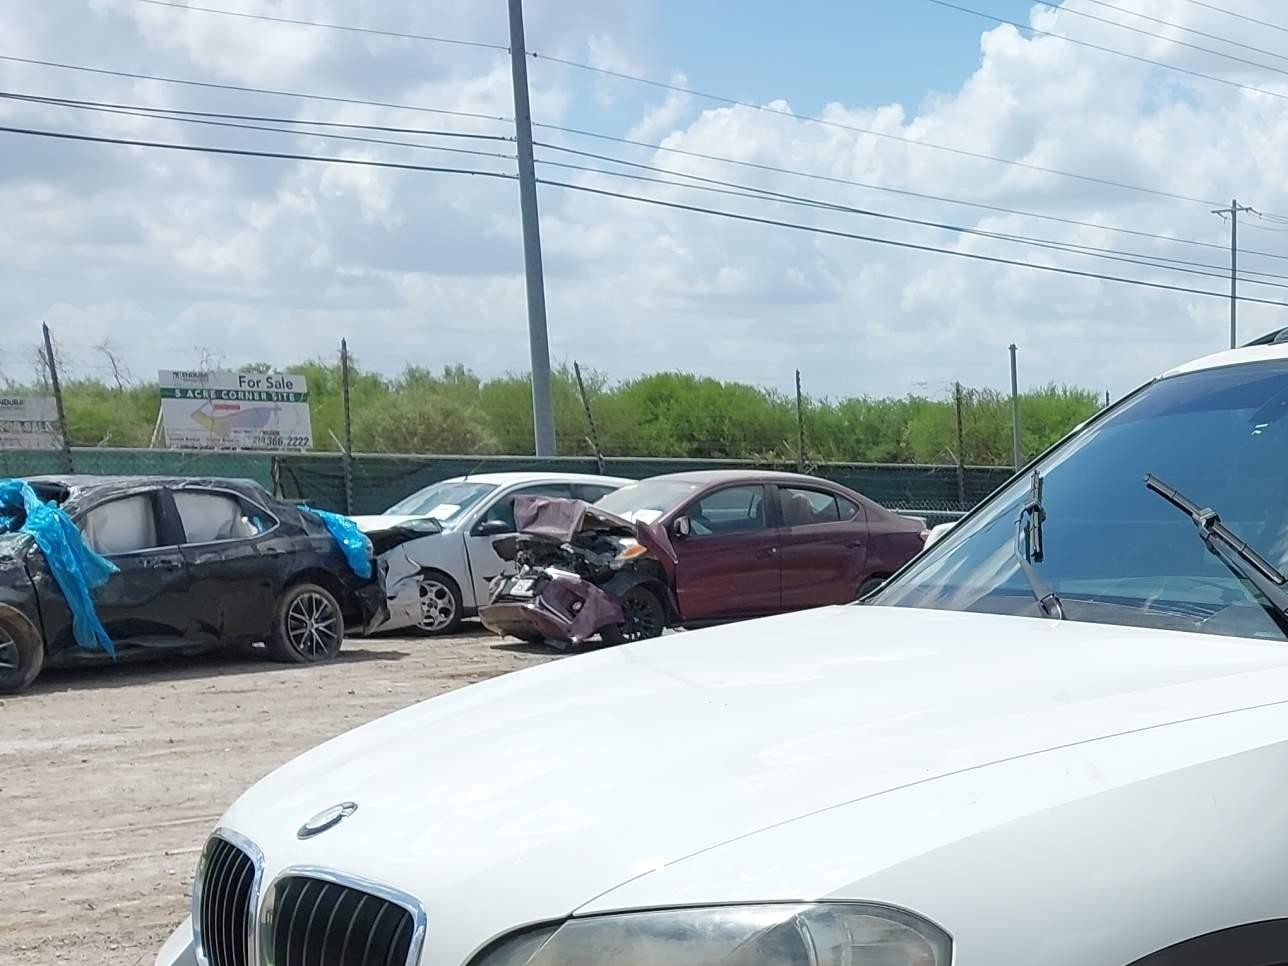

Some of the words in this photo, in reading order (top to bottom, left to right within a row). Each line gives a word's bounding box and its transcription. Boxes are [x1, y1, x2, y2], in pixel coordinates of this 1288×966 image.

[238, 375, 262, 389] For
[266, 377, 294, 391] Sale
[174, 388, 182, 399] 5
[186, 389, 217, 400] ACRE
[221, 390, 267, 401] CORNER
[271, 391, 296, 402] SITE
